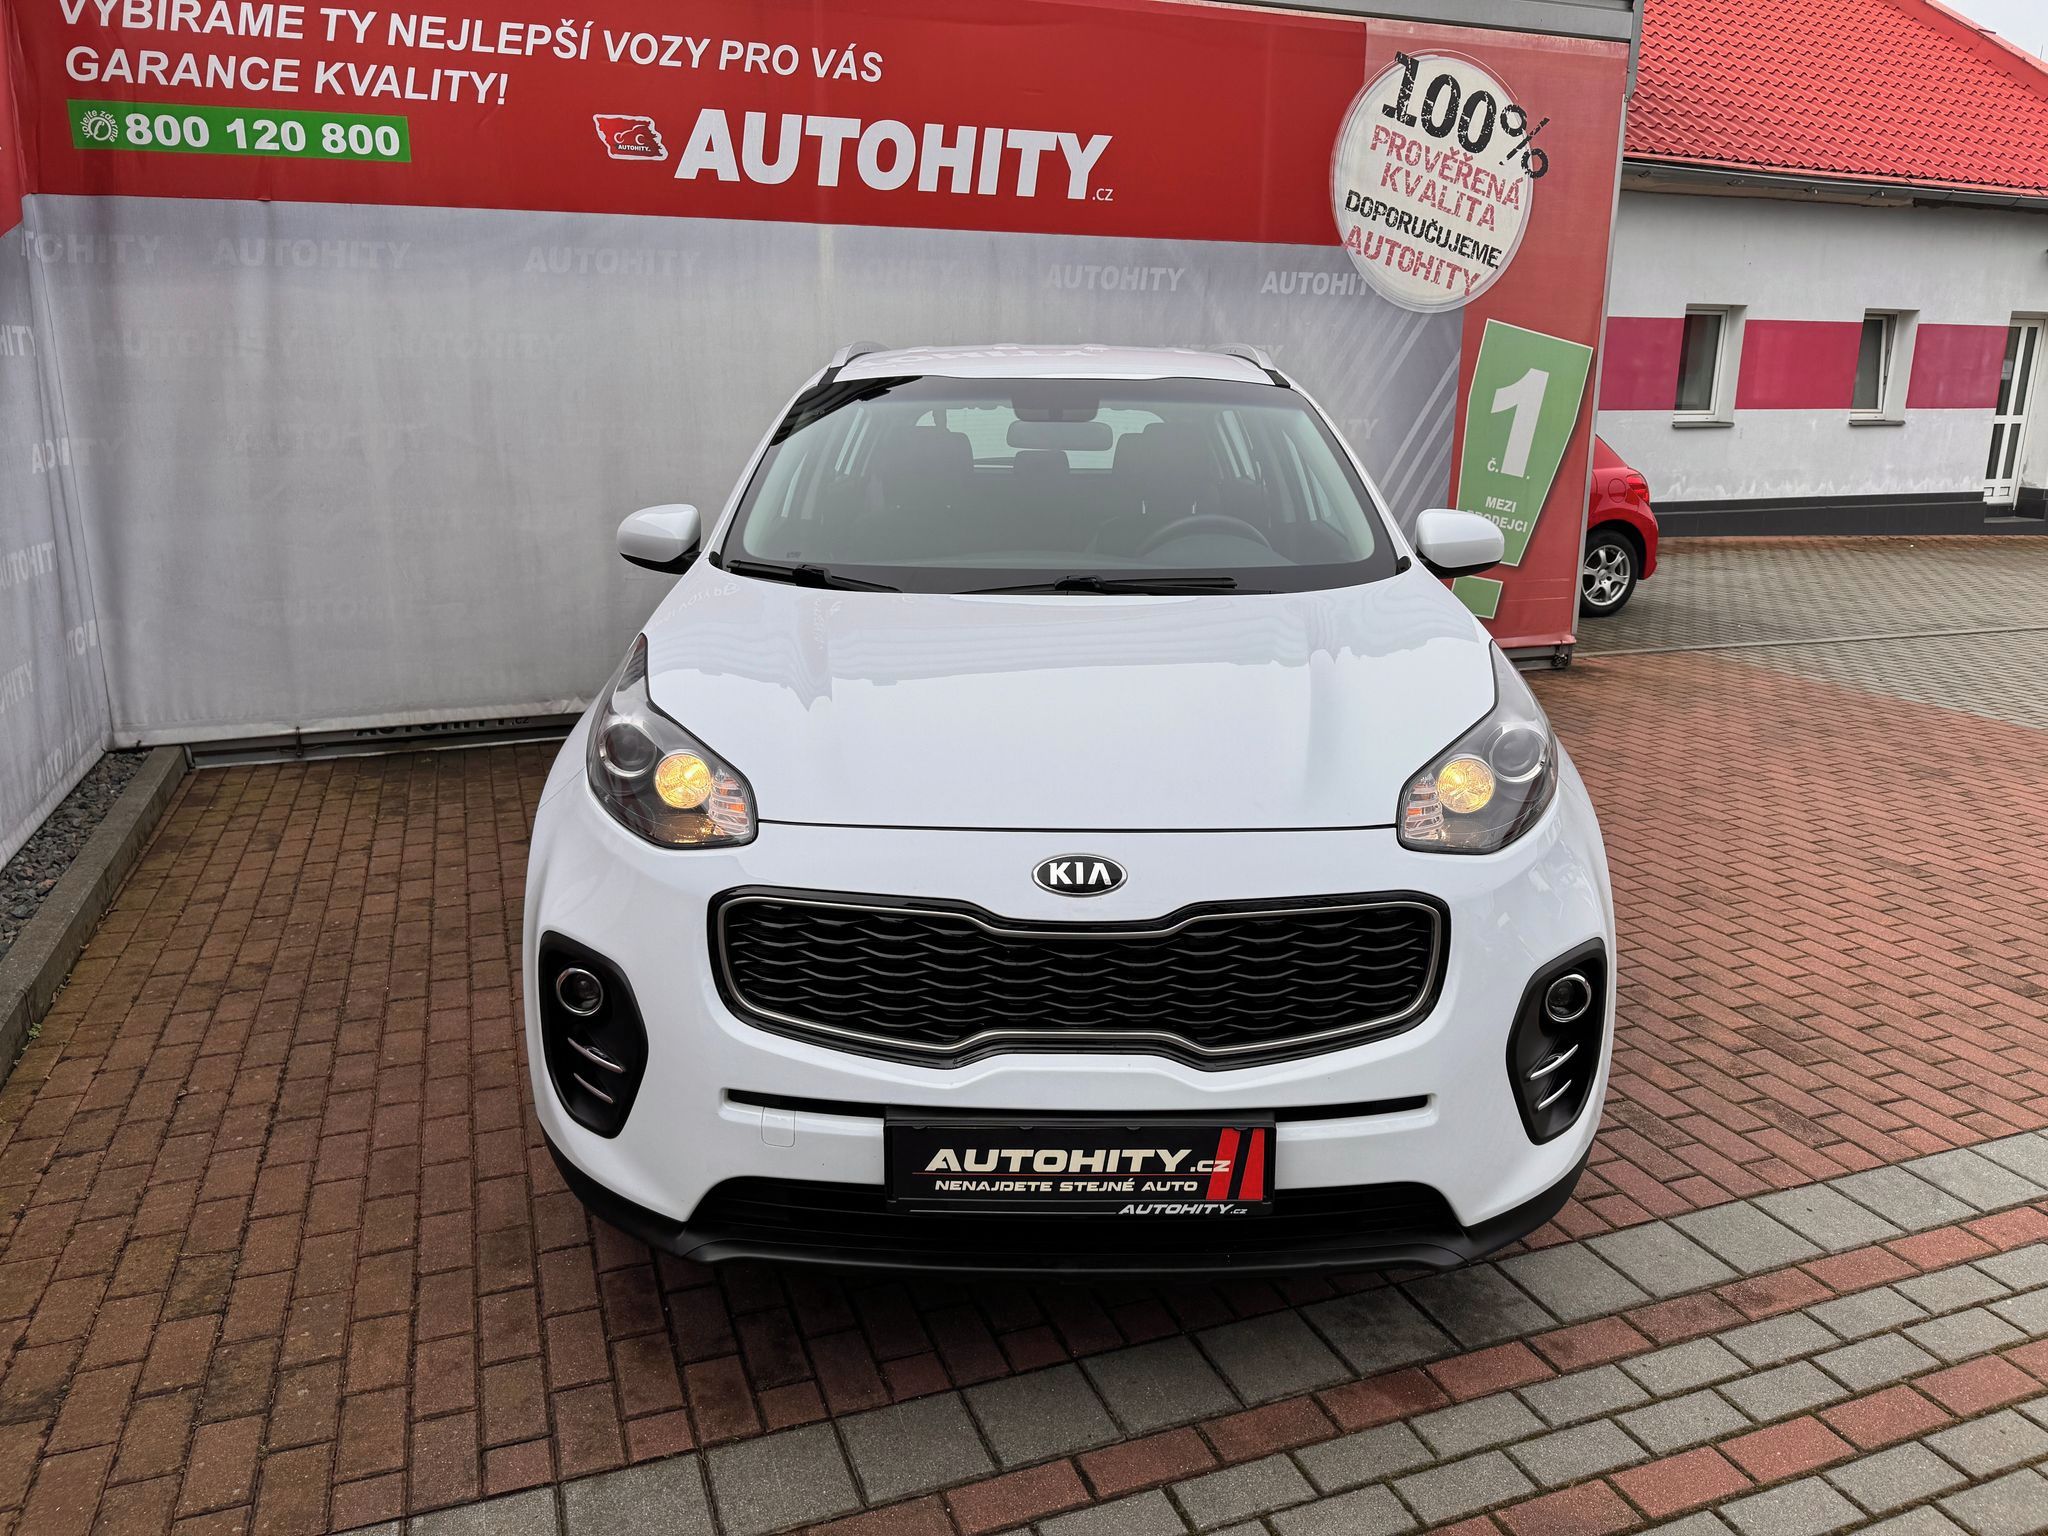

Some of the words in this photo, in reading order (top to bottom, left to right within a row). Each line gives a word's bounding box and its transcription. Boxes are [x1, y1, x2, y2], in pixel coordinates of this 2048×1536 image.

[320, 7, 378, 44] TY
[387, 12, 593, 60] NEJLEPŠÍ
[603, 30, 711, 69] VOZY
[719, 40, 799, 76] PRO
[812, 43, 884, 83] VÁS
[65, 46, 300, 92] GARANCE
[314, 61, 508, 105] KVALITY!
[125, 113, 210, 147] 800
[226, 118, 306, 152] 120
[321, 122, 400, 156] 800
[1381, 51, 1550, 179] 100%
[1370, 124, 1523, 210] PROVĚŘENÁ
[1380, 162, 1495, 232] KVALITA
[1345, 189, 1502, 269] DOPORUČUJEME
[1045, 263, 1186, 294] AUTOHITY
[1260, 270, 1378, 297] AUTOHIT
[1343, 225, 1481, 296] AUTOHITY
[1467, 510, 1528, 533] ODEJCI
[1485, 496, 1517, 513] MEZI
[1048, 862, 1112, 885] KIA
[935, 1180, 1053, 1192] NENAJDETE
[1059, 1178, 1136, 1193] STEJNÉ
[1140, 1181, 1198, 1193] AUTO
